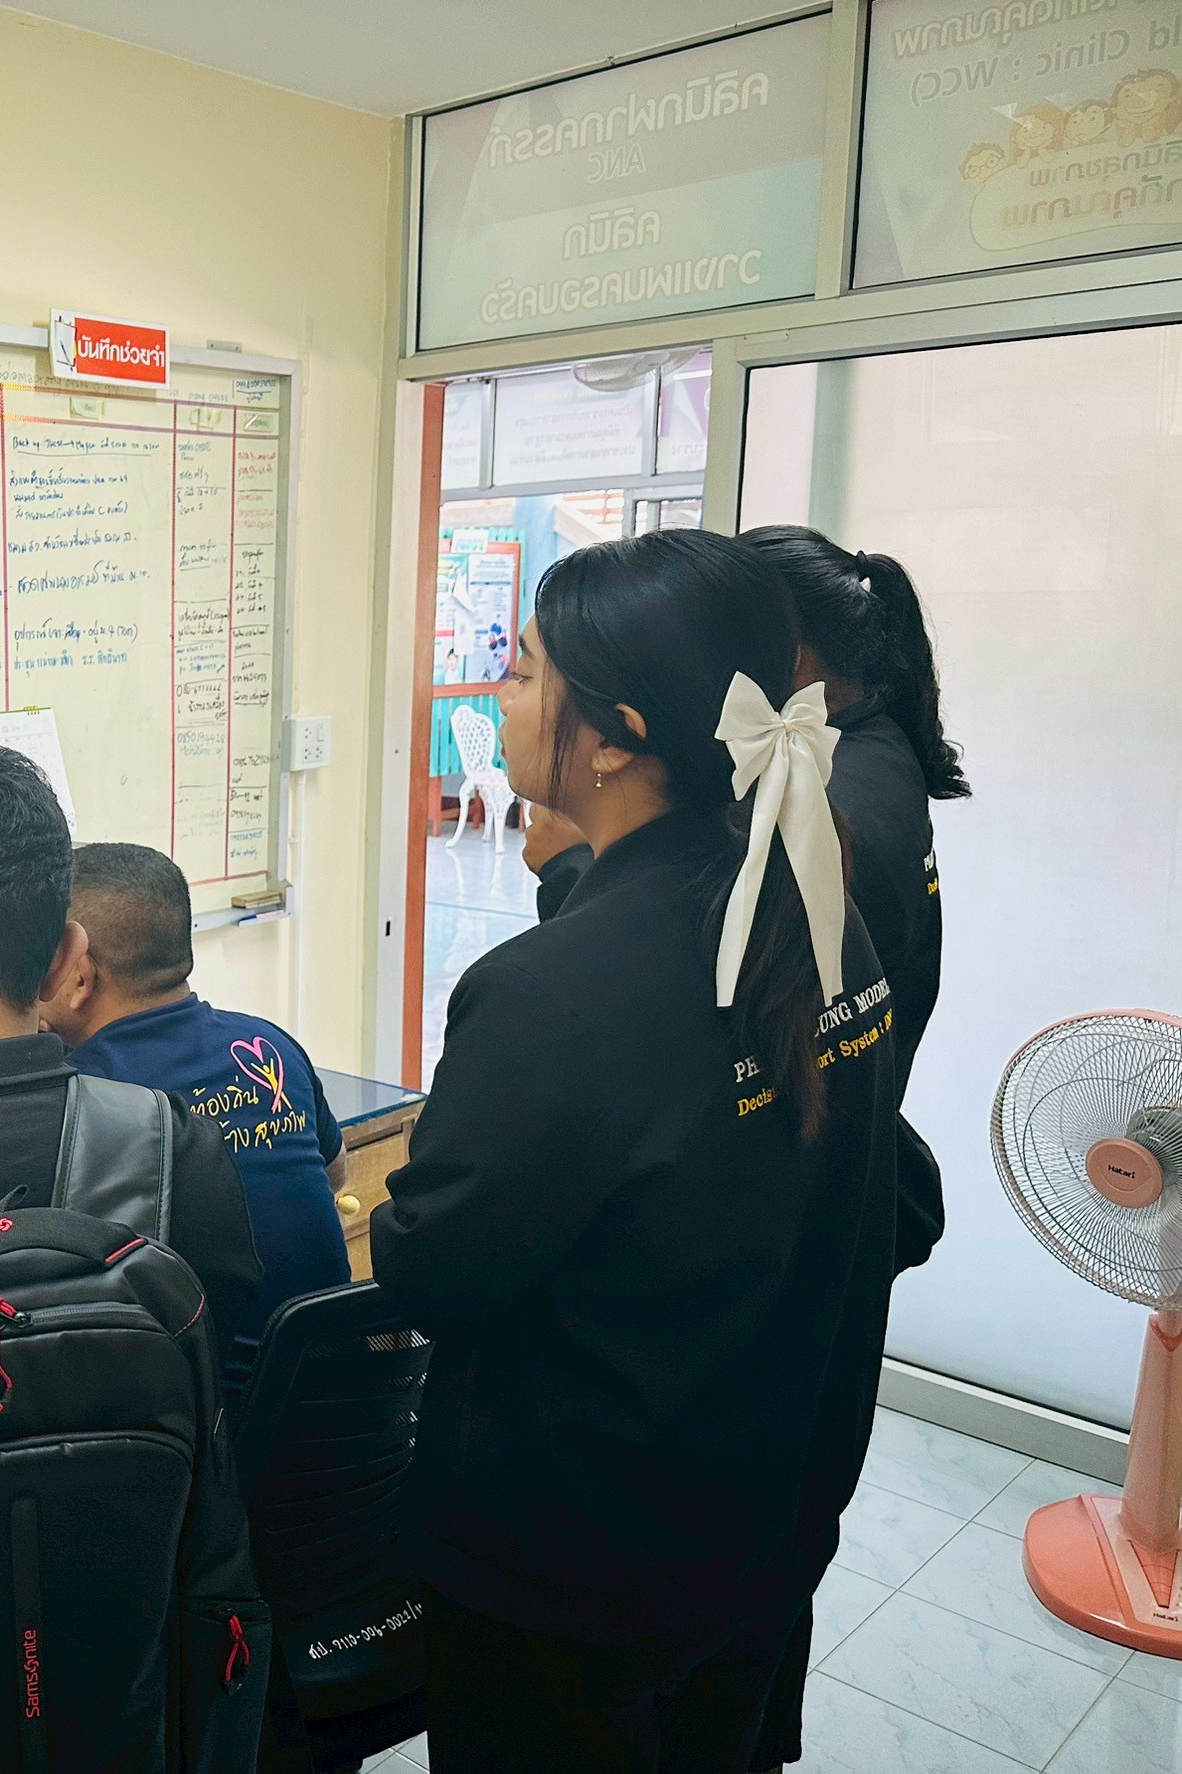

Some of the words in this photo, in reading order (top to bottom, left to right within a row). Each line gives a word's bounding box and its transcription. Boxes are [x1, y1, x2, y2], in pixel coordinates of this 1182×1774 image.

[77, 334, 166, 369] บันทึกช่วยจำ
[1108, 1164, 1136, 1179] Hatari
[22, 1628, 40, 1718] Samsonite
